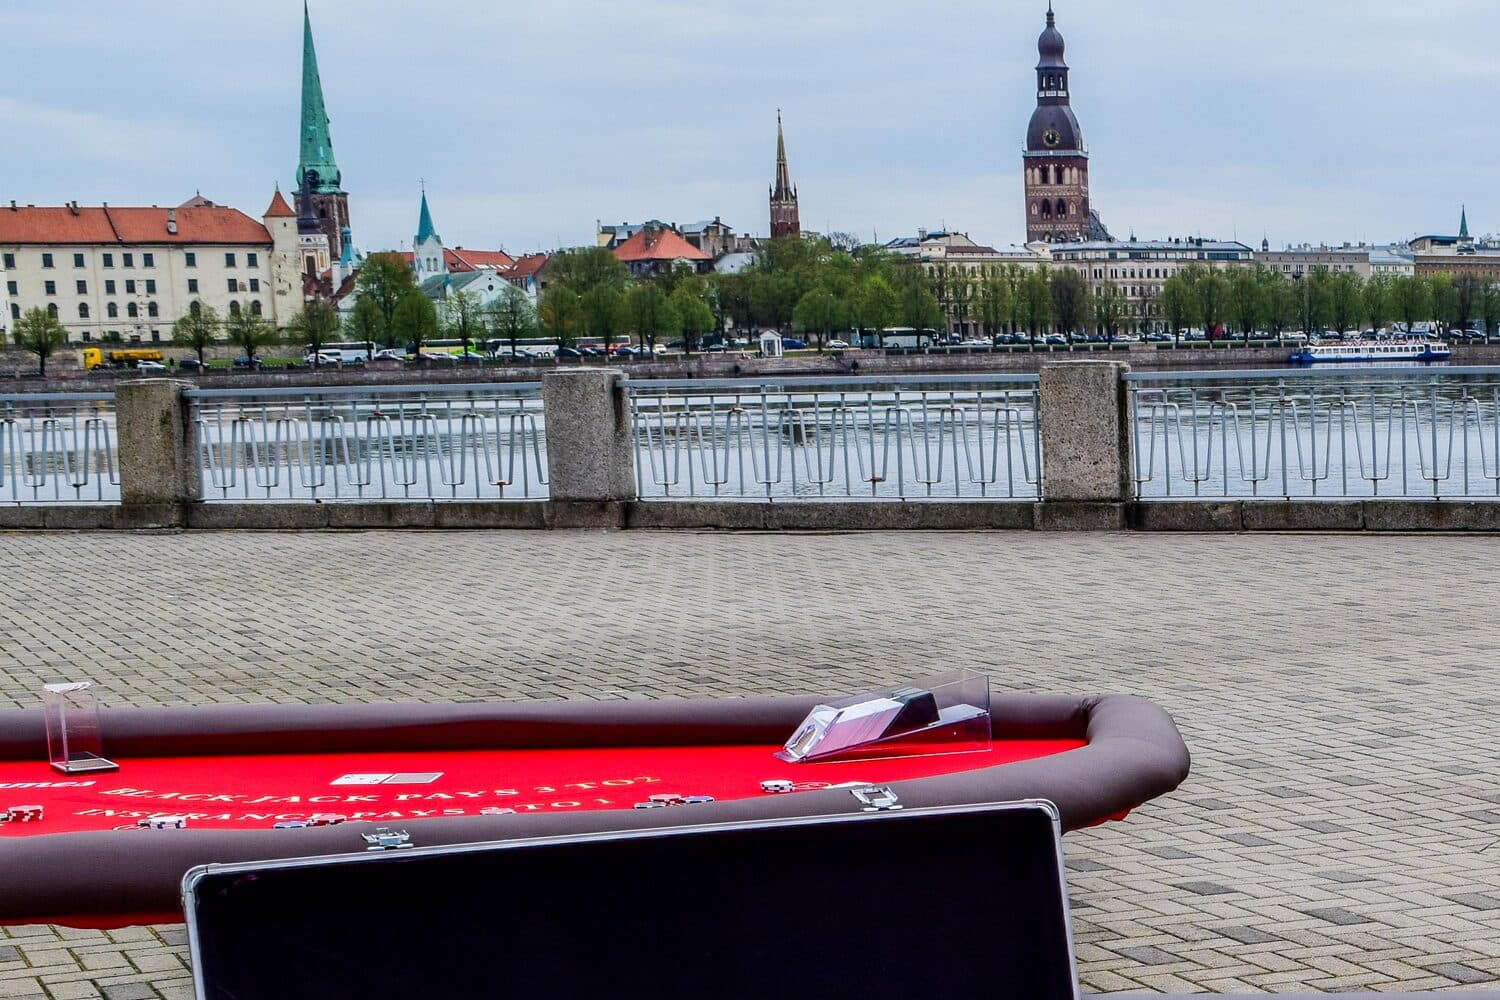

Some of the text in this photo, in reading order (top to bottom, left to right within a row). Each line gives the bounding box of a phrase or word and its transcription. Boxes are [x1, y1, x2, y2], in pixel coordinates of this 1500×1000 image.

[98, 788, 248, 802] BLACK
[242, 795, 381, 803] JACK
[394, 789, 519, 801] PAYS
[349, 808, 465, 819] PAYS
[514, 801, 581, 811] TO
